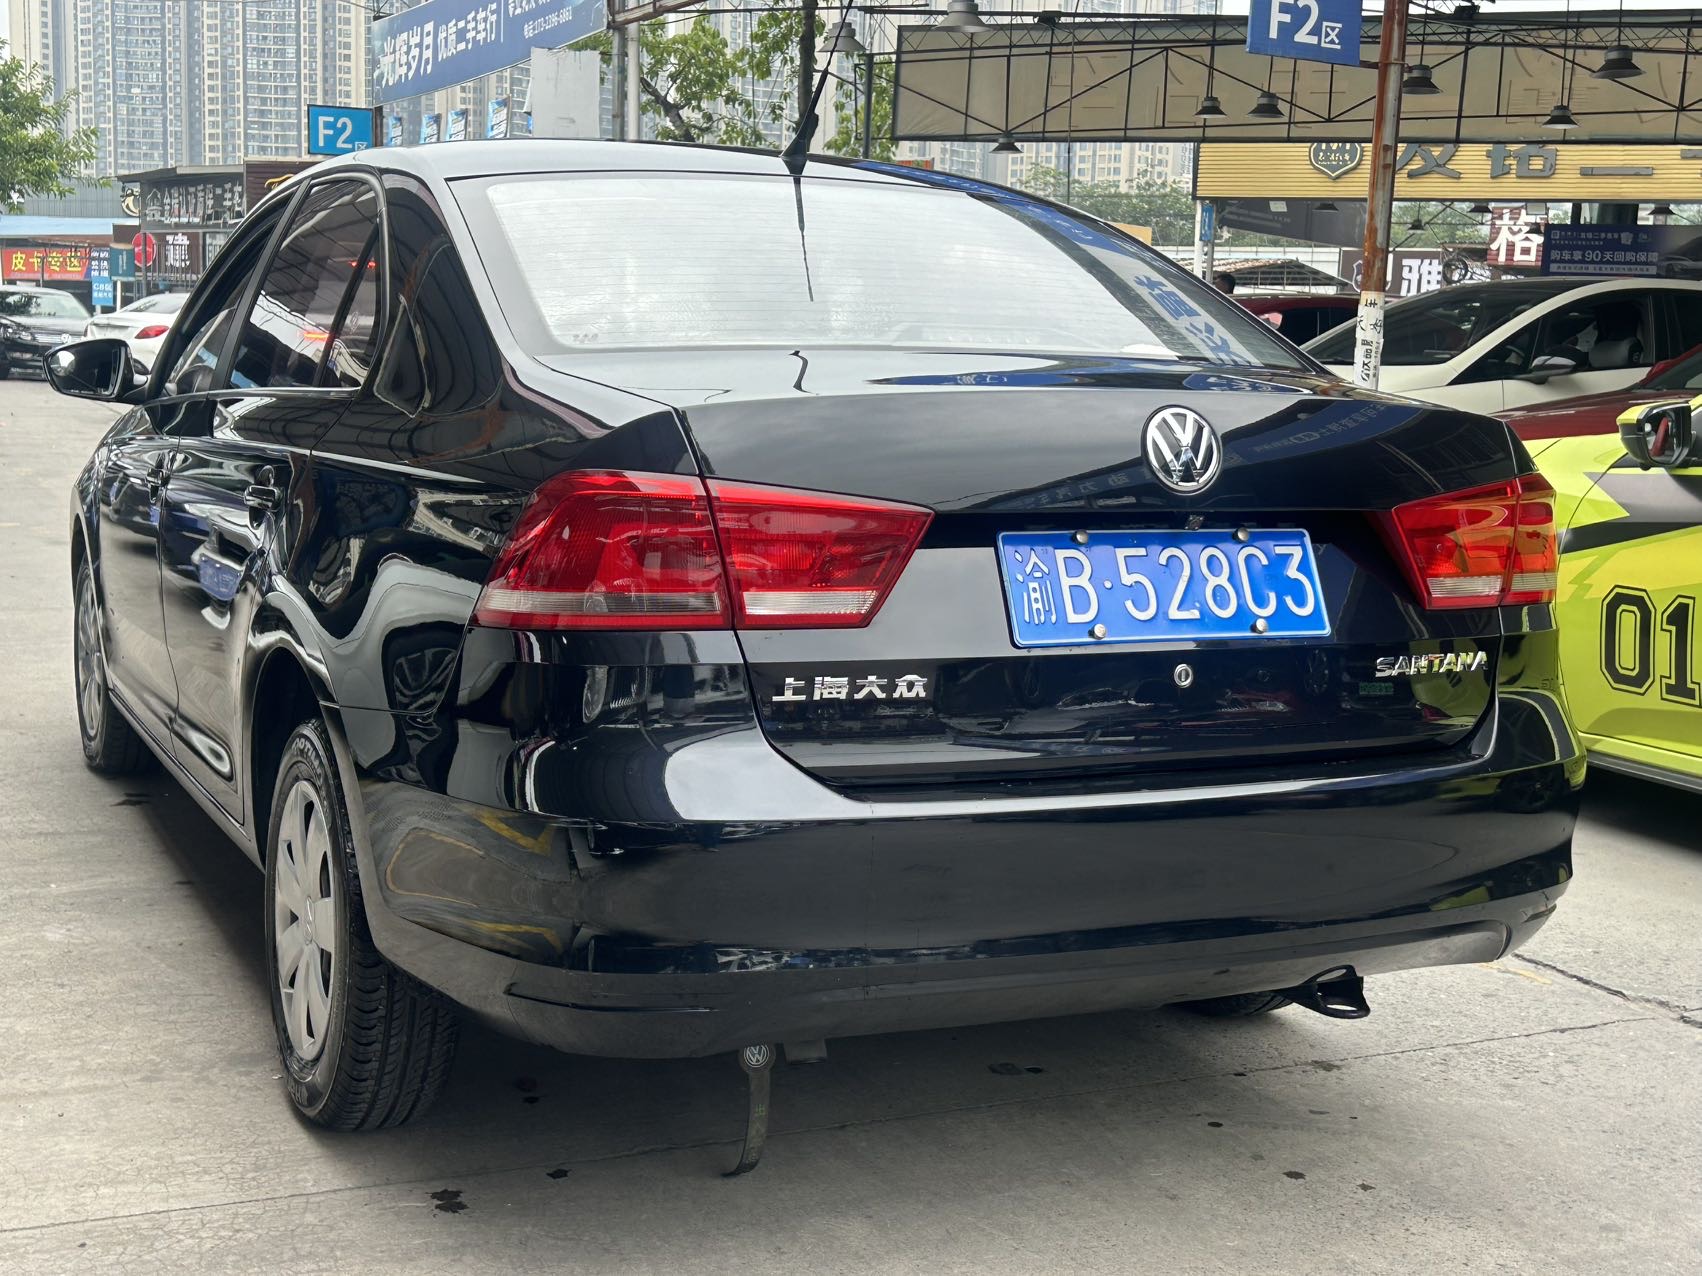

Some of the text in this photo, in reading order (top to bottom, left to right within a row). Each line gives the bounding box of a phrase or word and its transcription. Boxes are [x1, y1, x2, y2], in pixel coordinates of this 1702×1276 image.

[1268, 0, 1342, 49] F2区
[375, 2, 497, 88] 光辉岁月 优质二手车行
[1375, 651, 1488, 678] SANTANA
[771, 674, 928, 702] 上海大众
